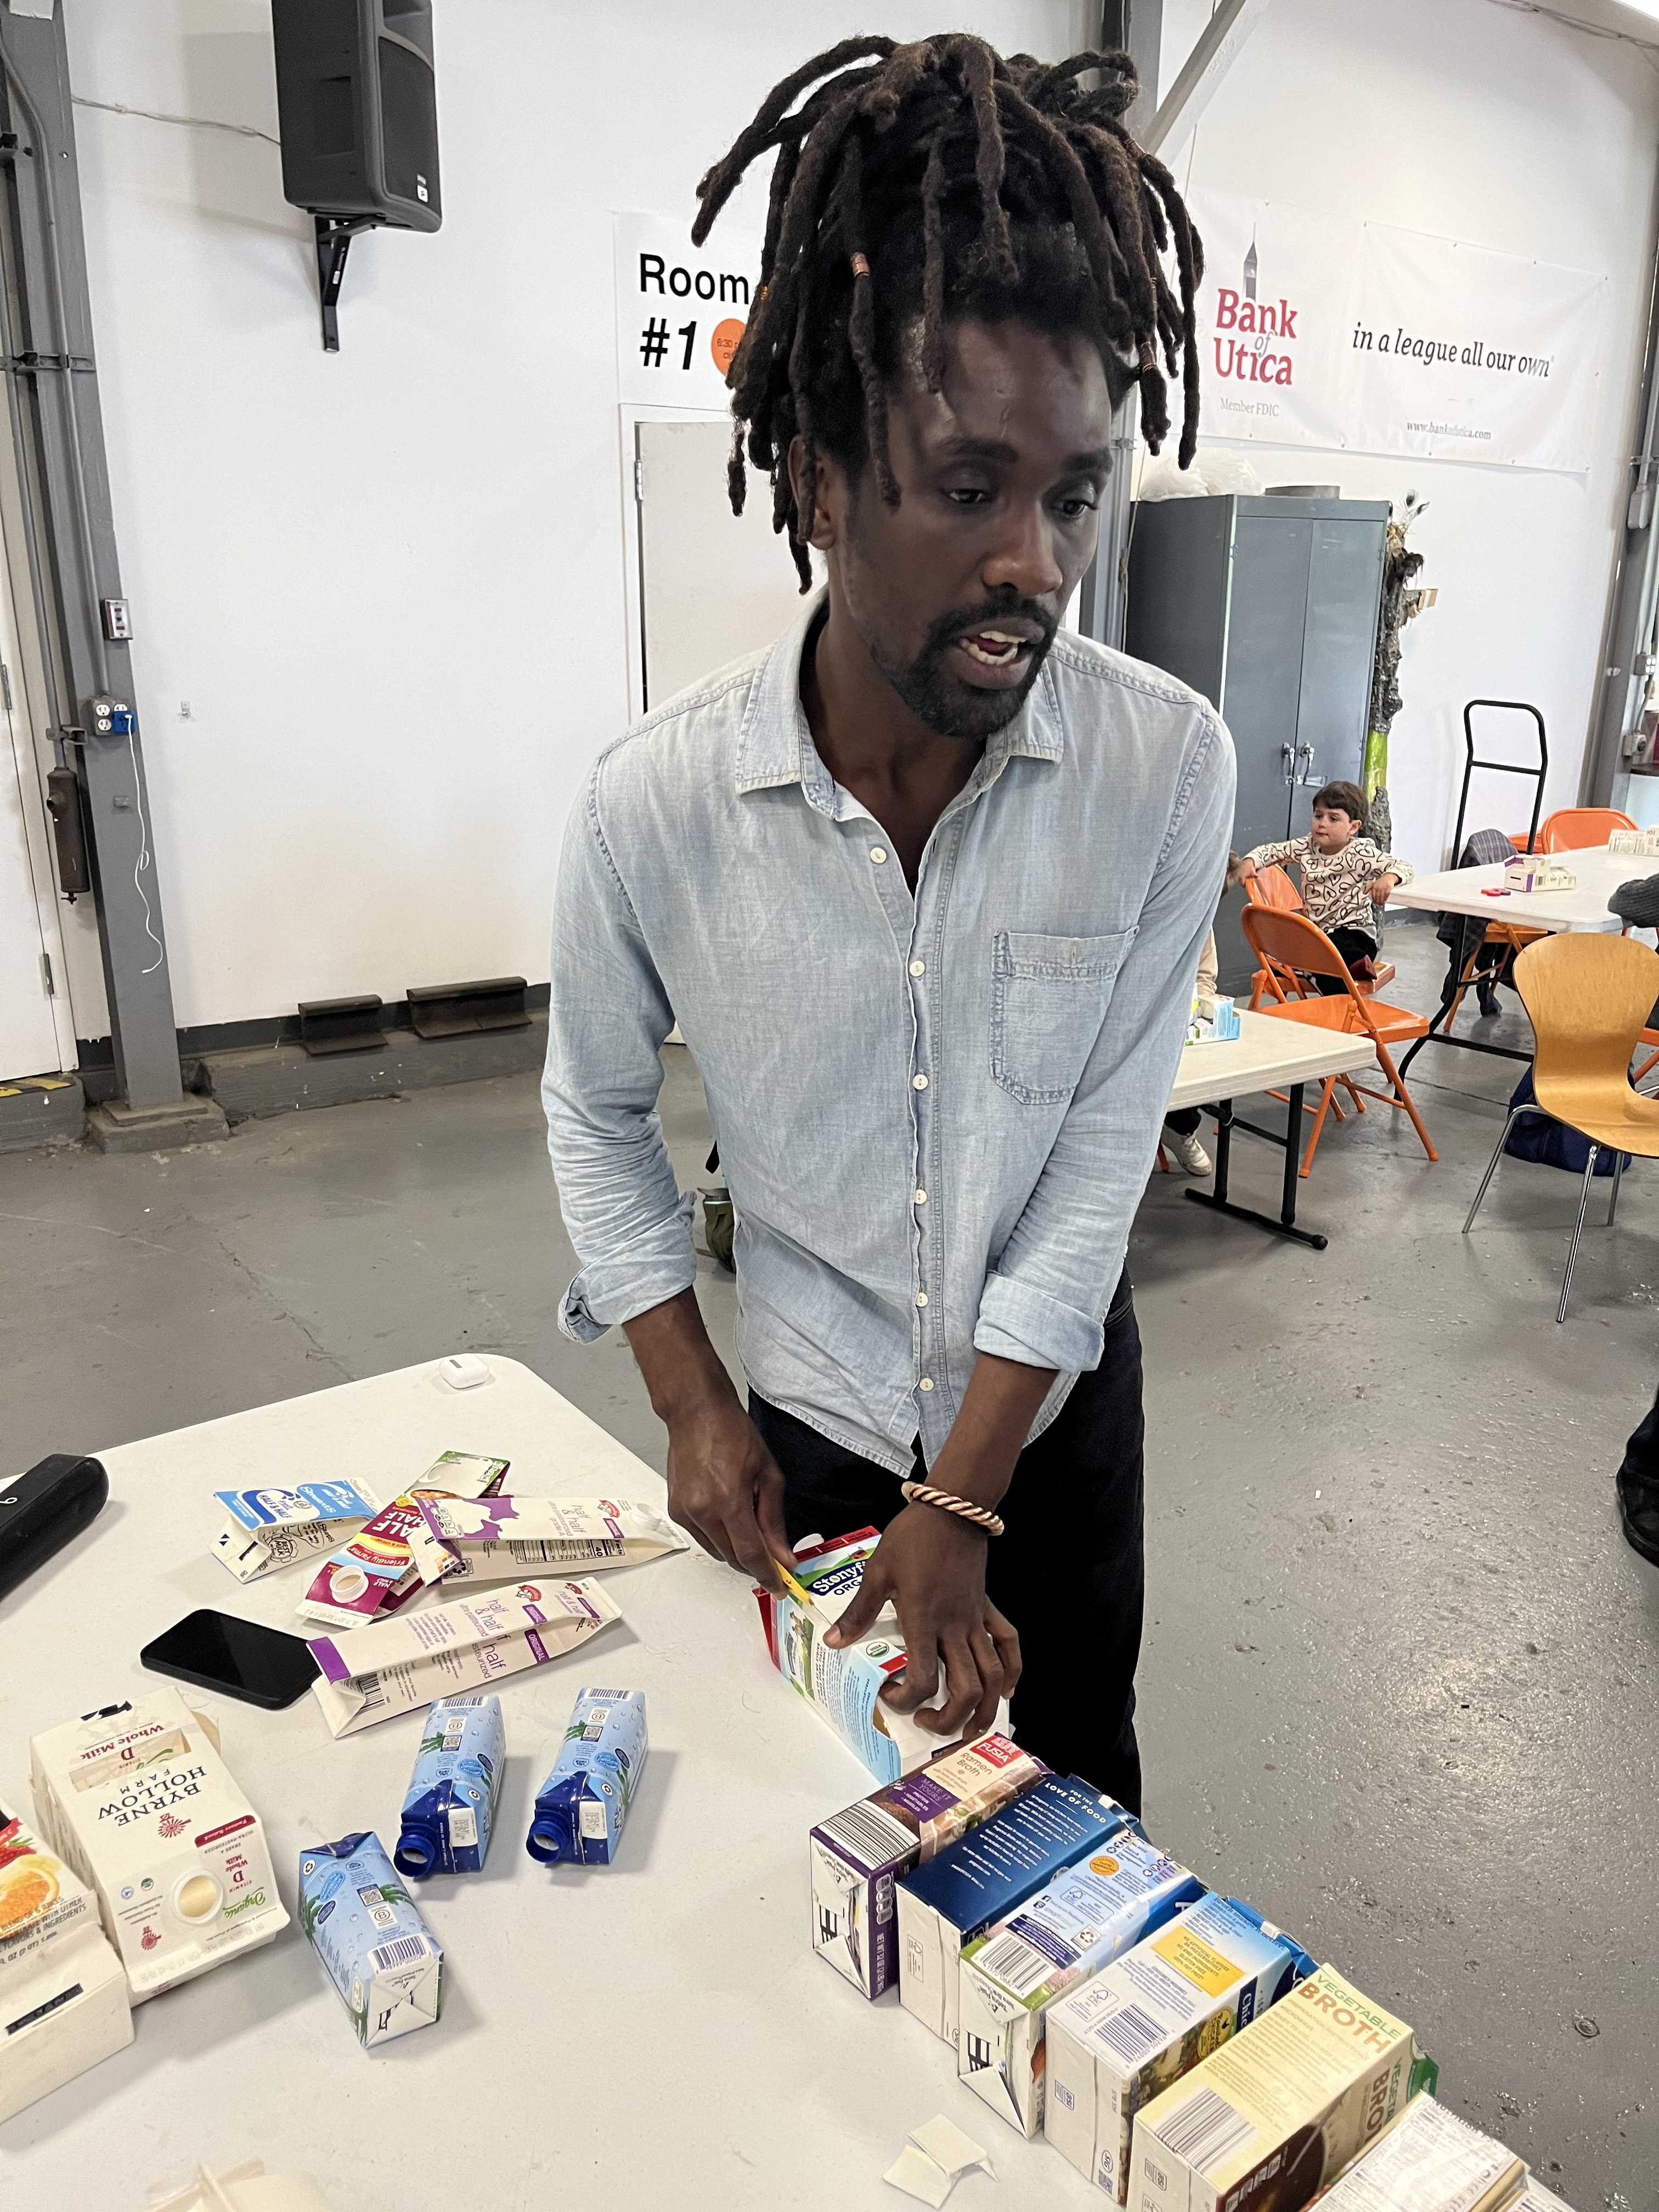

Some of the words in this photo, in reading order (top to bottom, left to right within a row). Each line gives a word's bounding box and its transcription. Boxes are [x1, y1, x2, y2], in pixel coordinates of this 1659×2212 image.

[640, 253, 749, 304] Room
[1216, 288, 1297, 338] Bank
[639, 317, 698, 370] #1
[1255, 331, 1274, 358] of
[1352, 321, 1372, 350] in
[1378, 334, 1390, 352] a
[1395, 329, 1457, 365] league
[1462, 341, 1483, 366] all
[1487, 351, 1516, 371] our
[1518, 356, 1549, 377] own
[1214, 337, 1293, 385] Utica
[1221, 397, 1255, 414] Member
[1256, 403, 1279, 417] FDIC
[571, 1505, 592, 1519] half
[371, 1520, 416, 1537] ALF
[566, 1517, 586, 1533] half
[275, 1541, 285, 1556] MILK
[281, 1541, 290, 1554] BEST
[351, 1547, 371, 1561] Farms
[595, 1547, 603, 1556] 40
[371, 1555, 405, 1566] Friendly
[812, 1561, 866, 1592] Stonyf
[486, 1599, 509, 1613] half
[481, 1614, 504, 1630] half
[483, 1643, 506, 1669] half
[528, 1634, 545, 1661] ORIGINAL
[117, 1725, 165, 1745] Whole
[80, 1742, 115, 1760] Milk
[121, 1746, 136, 1761] D
[977, 1742, 1009, 1763] FUSIA
[957, 1759, 980, 1776] Broth
[960, 1752, 992, 1775] Ramen
[120, 1769, 171, 1795] FARM
[919, 1784, 942, 1801] YOURS
[98, 1766, 207, 1820] HOLLOW
[1045, 1782, 1068, 1798] LOVE
[1068, 1797, 1081, 1805] OF
[1081, 1805, 1107, 1823] FOOD
[1070, 1790, 1082, 1798] FOR
[1082, 1797, 1093, 1805] THE
[114, 1782, 201, 1827] BYRNE
[225, 1854, 242, 1865] Milk
[225, 1859, 248, 1872] Whole
[233, 1870, 244, 1883] D
[223, 1889, 266, 1918] Organic
[3, 1930, 34, 1950] FLAVORS
[43, 1903, 86, 1931] INGREDIENTS
[991, 1996, 1007, 2012] Tetra
[1241, 1993, 1252, 2028] Chic
[1317, 1974, 1402, 2040] VEGETABLE
[1297, 1982, 1391, 2053] BROTH
[1383, 2058, 1402, 2125] VEGETA
[1365, 2067, 1390, 2142] BRO
